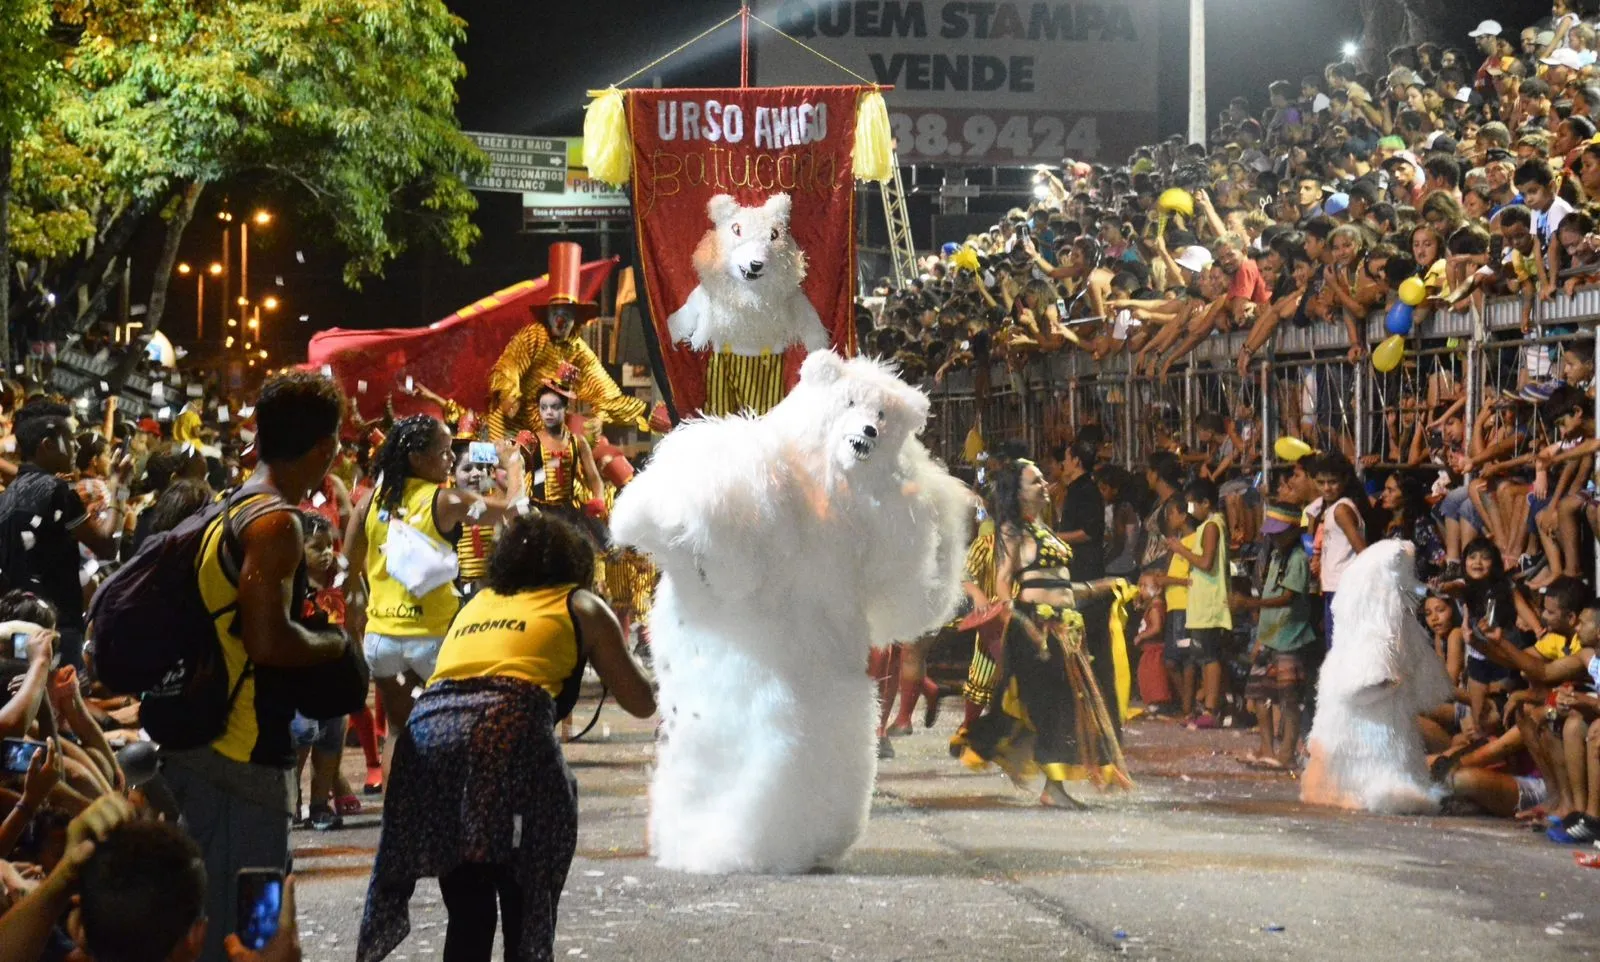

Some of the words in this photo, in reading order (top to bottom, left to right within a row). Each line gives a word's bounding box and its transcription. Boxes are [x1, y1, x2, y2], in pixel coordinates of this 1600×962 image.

[777, 0, 927, 39] QUEM
[940, 2, 1138, 42] STAMPA
[868, 53, 1035, 92] VENDE
[657, 99, 744, 143] URSO
[754, 101, 828, 150] AMIGO
[477, 136, 508, 148] TREZE
[511, 139, 524, 149] DE
[526, 140, 552, 150] MAIO
[489, 152, 533, 165] GUARIBE
[475, 177, 503, 188] CABO
[504, 179, 546, 191] BRANCO
